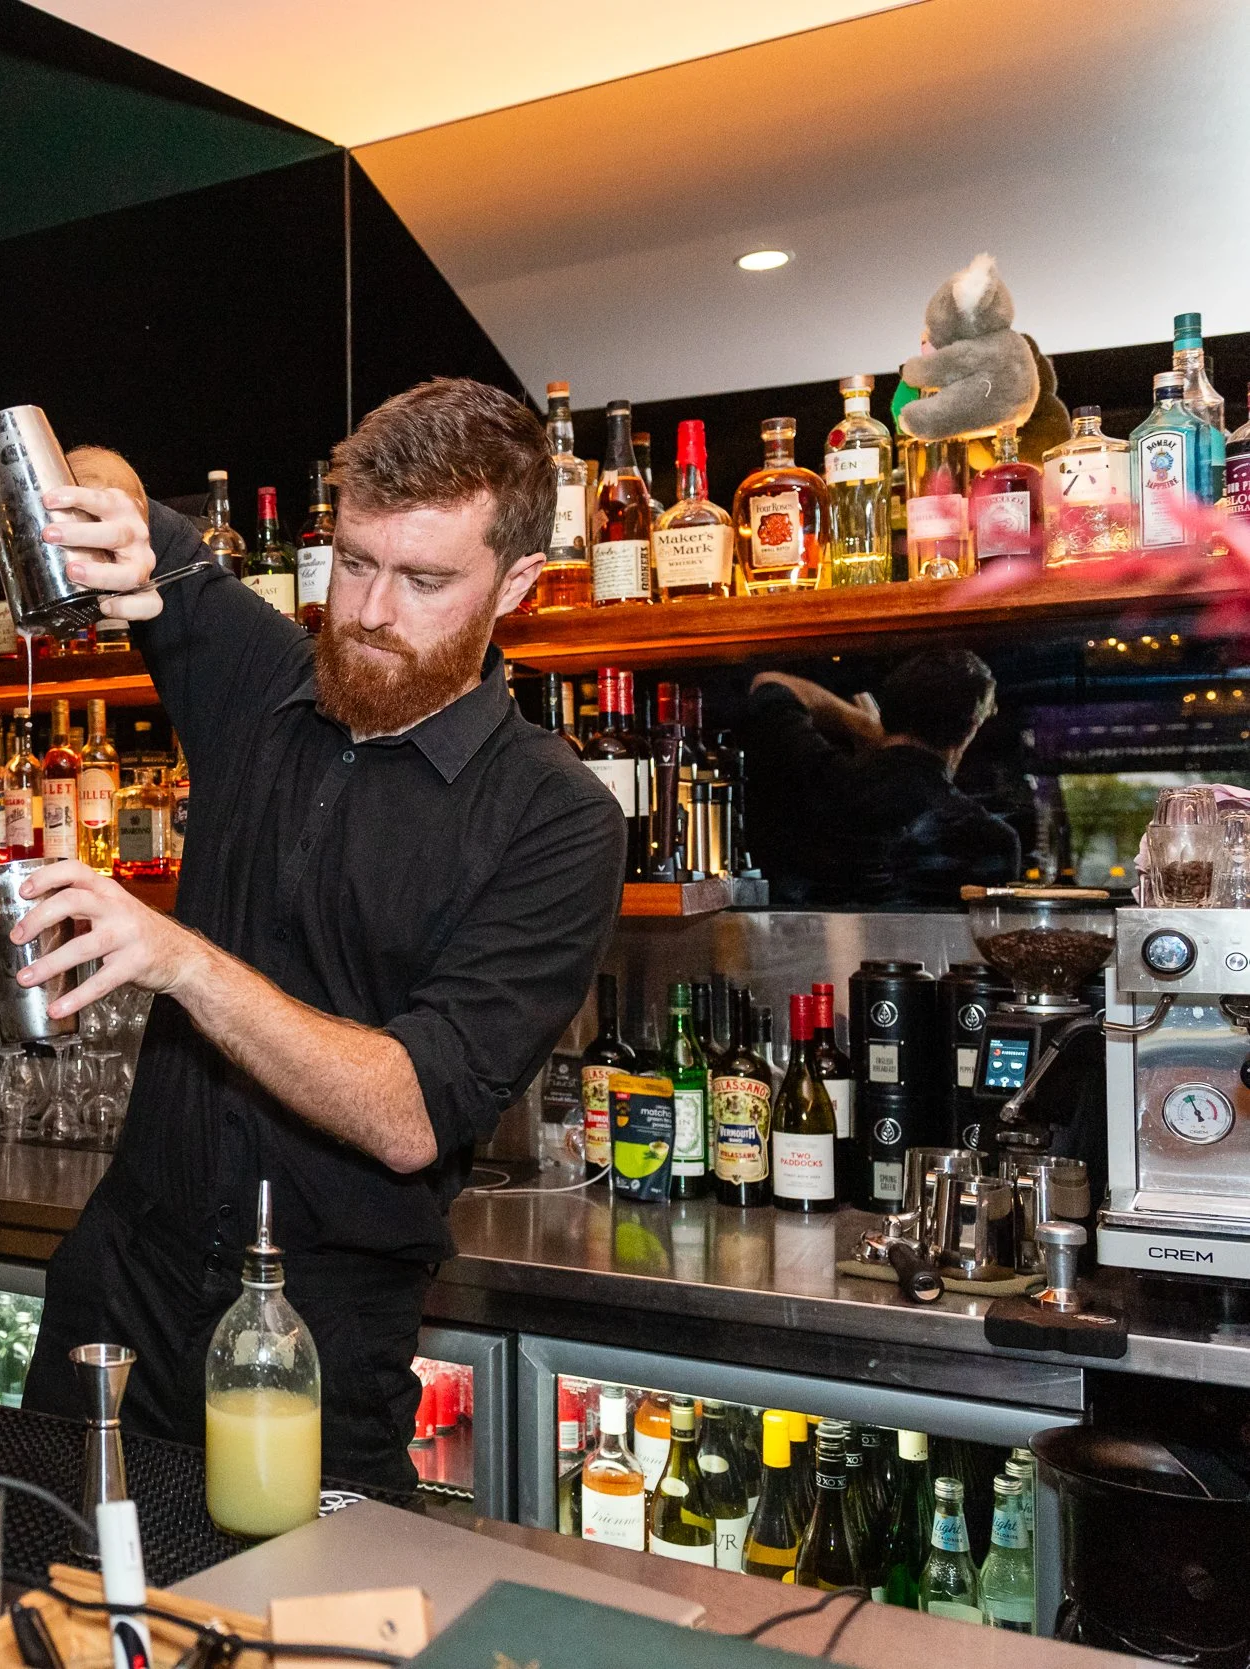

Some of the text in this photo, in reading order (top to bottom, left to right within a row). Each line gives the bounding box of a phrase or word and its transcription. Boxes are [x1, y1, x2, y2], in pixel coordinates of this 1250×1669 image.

[1146, 439, 1177, 453] BOMBAY
[834, 462, 858, 472] TEN
[1145, 476, 1180, 489] SAPPHIRE
[658, 532, 714, 545] Maker's
[673, 544, 714, 556] Mark
[791, 1152, 811, 1160] TWO
[780, 1158, 824, 1168] PADDOCKS
[1148, 1246, 1214, 1264] CREM
